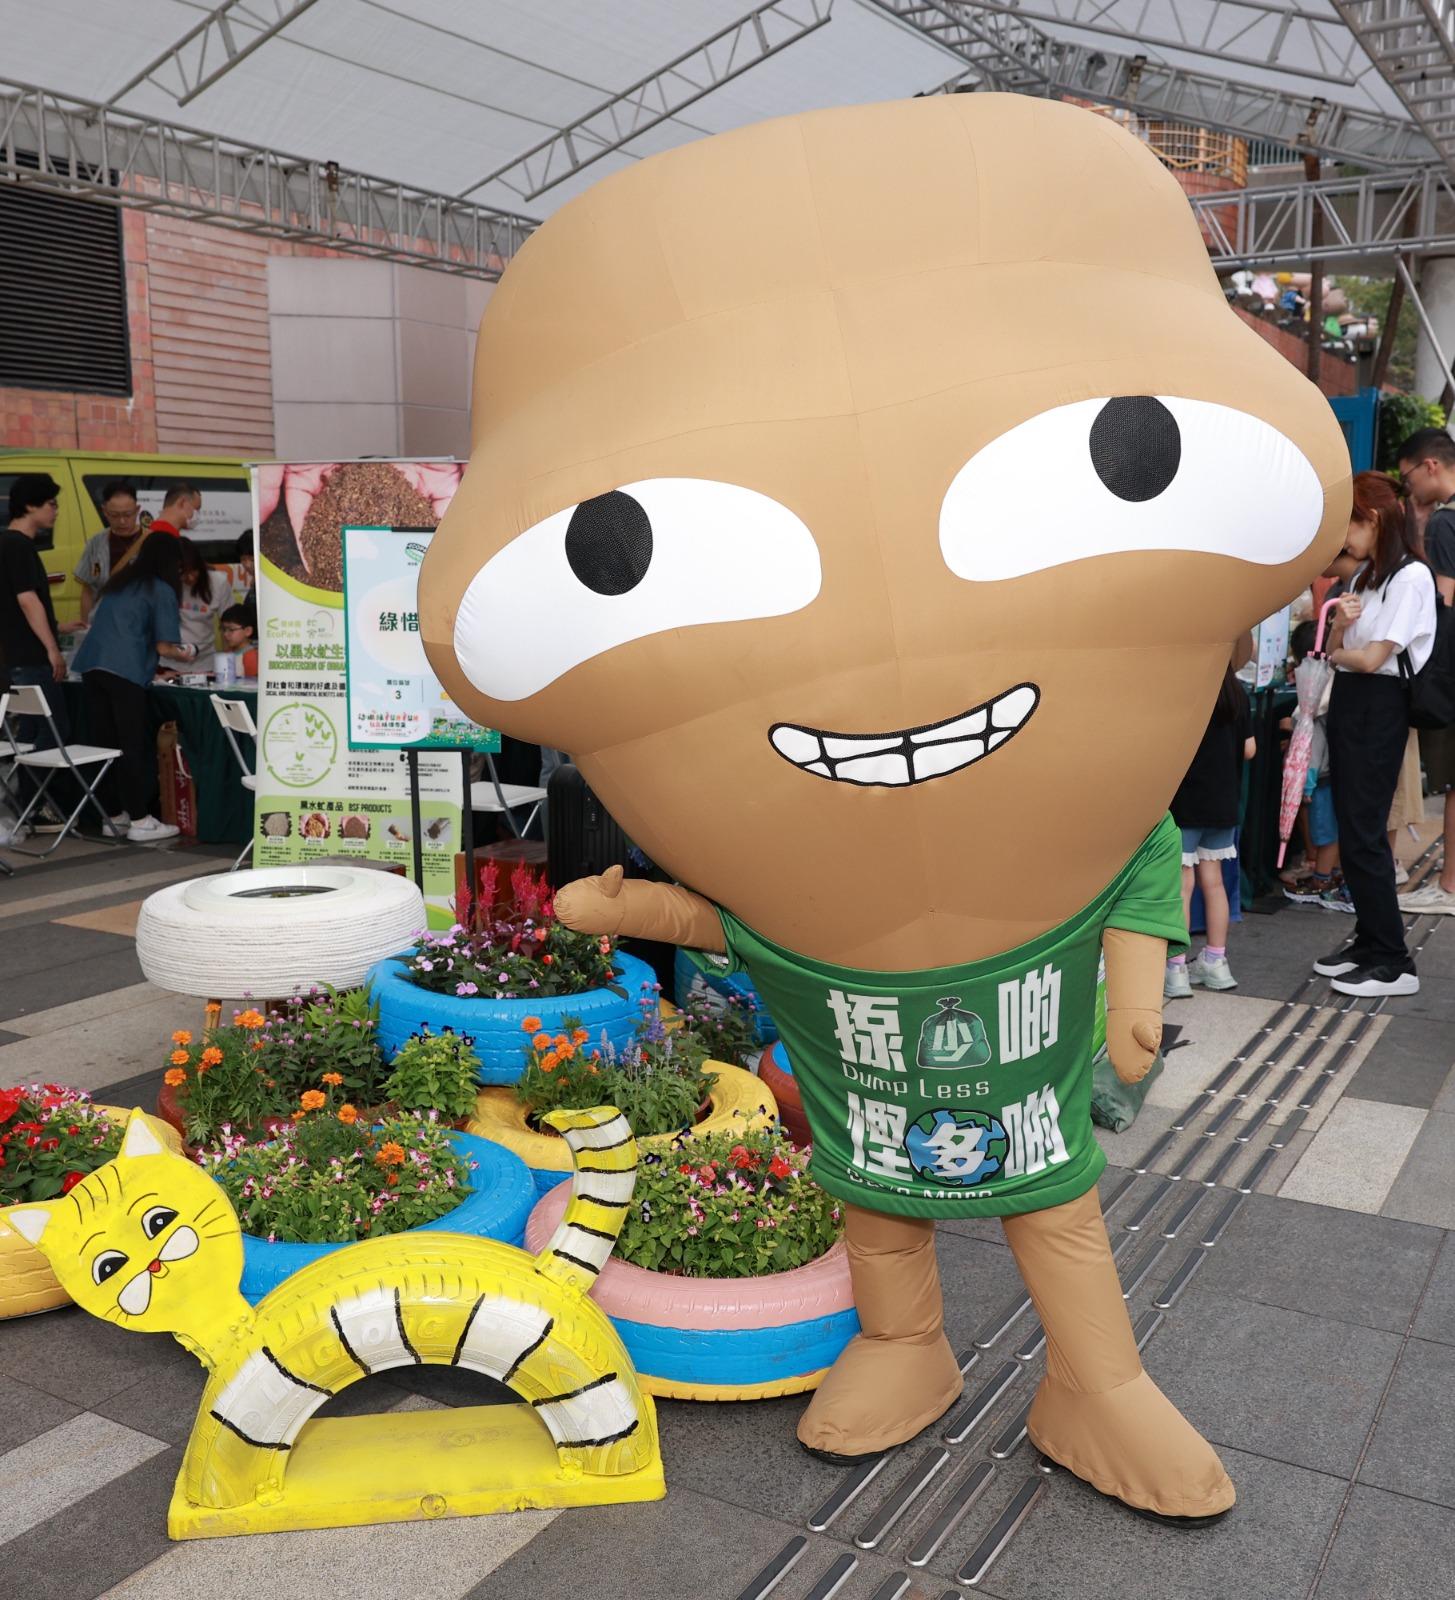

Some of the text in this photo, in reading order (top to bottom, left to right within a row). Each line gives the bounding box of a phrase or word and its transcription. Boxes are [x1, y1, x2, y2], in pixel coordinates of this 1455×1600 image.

[379, 611, 419, 632] 綠惜
[395, 690, 402, 700] 3
[360, 803, 392, 813] PRODUCTS
[842, 1062, 990, 1099] Dump Less
